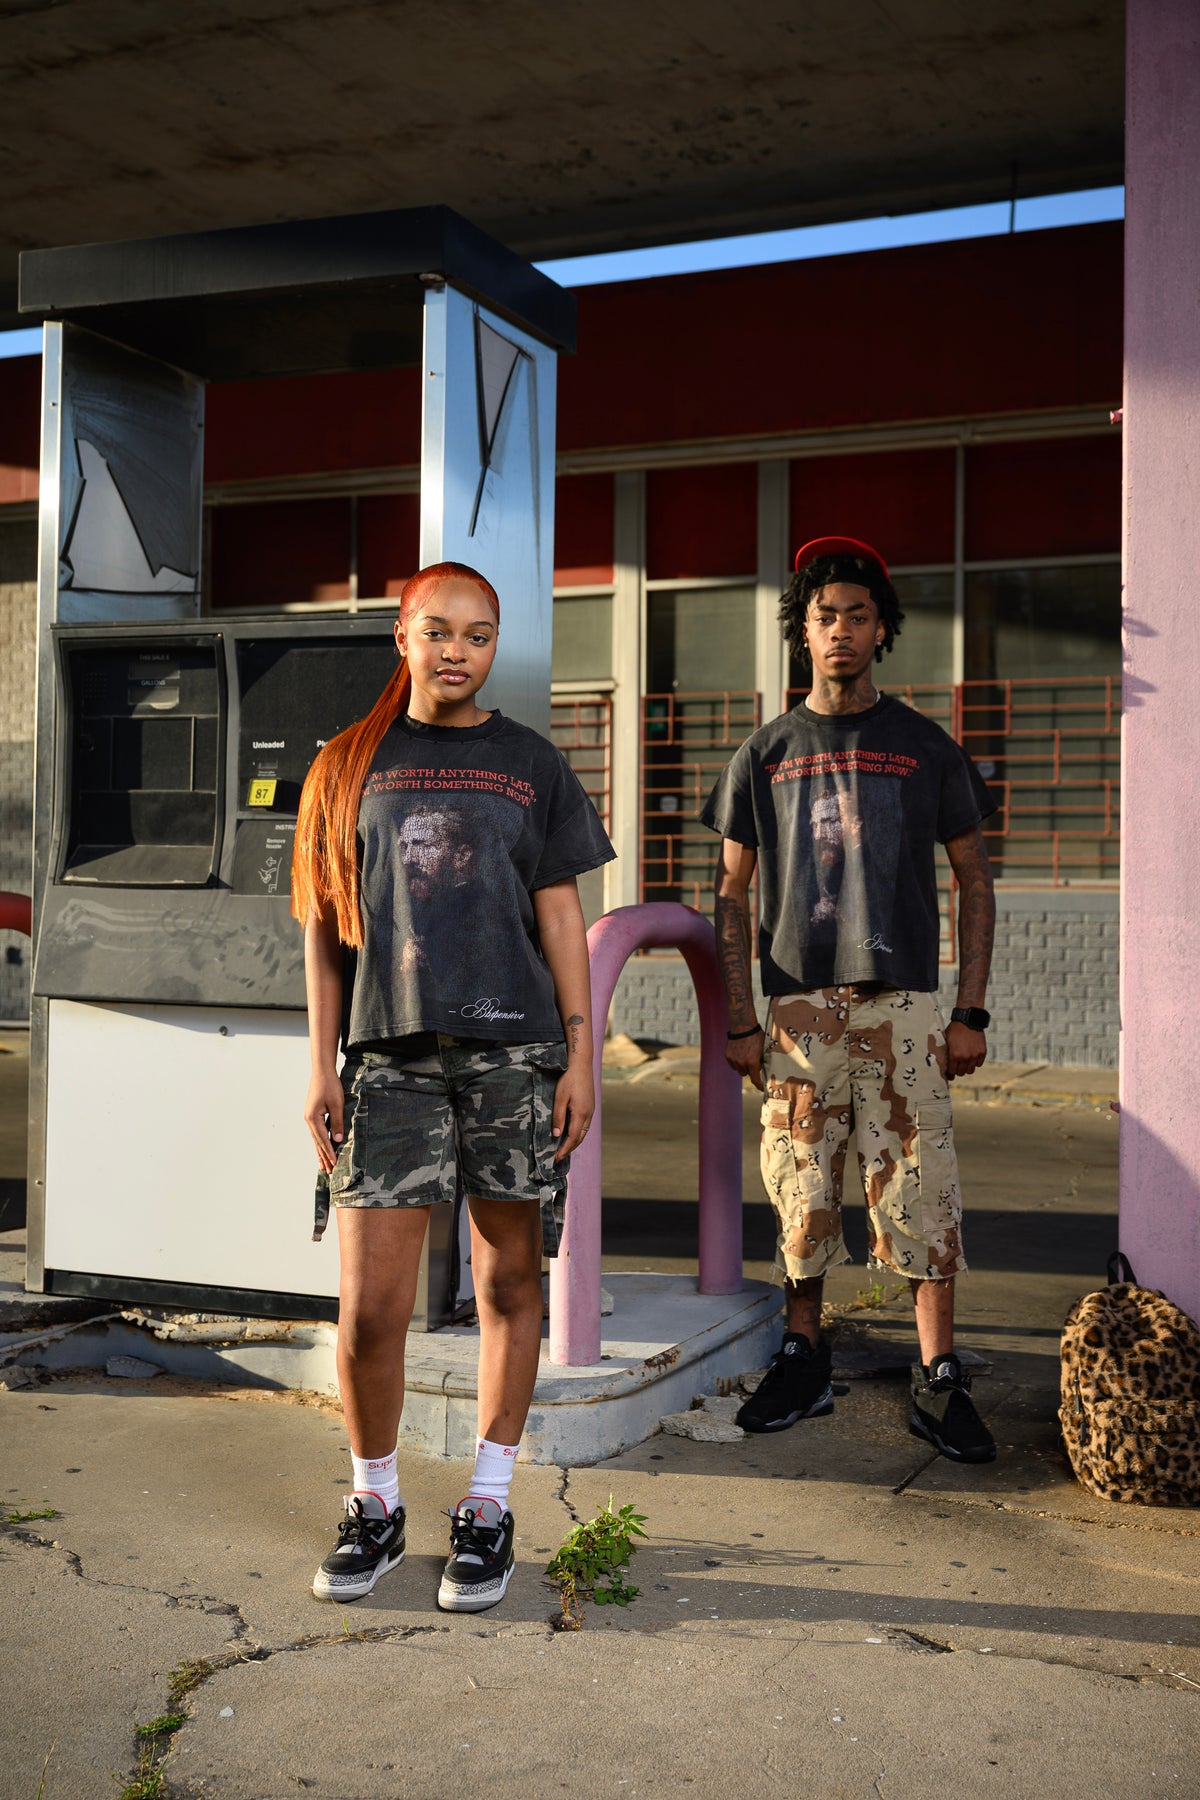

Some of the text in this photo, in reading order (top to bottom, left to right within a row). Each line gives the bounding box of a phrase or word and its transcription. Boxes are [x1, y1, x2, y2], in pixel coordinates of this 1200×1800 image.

[252, 740, 285, 749] Unleaded
[794, 751, 831, 767] WORTH
[833, 750, 887, 762] ANYTHING
[386, 768, 434, 780] WORTH
[438, 769, 508, 783] ANYTHING
[787, 764, 823, 780] WORTH
[824, 760, 883, 774] SOMETHING
[373, 780, 423, 793] WORTH
[424, 780, 504, 793] SOMETHING
[255, 788, 269, 800] 87
